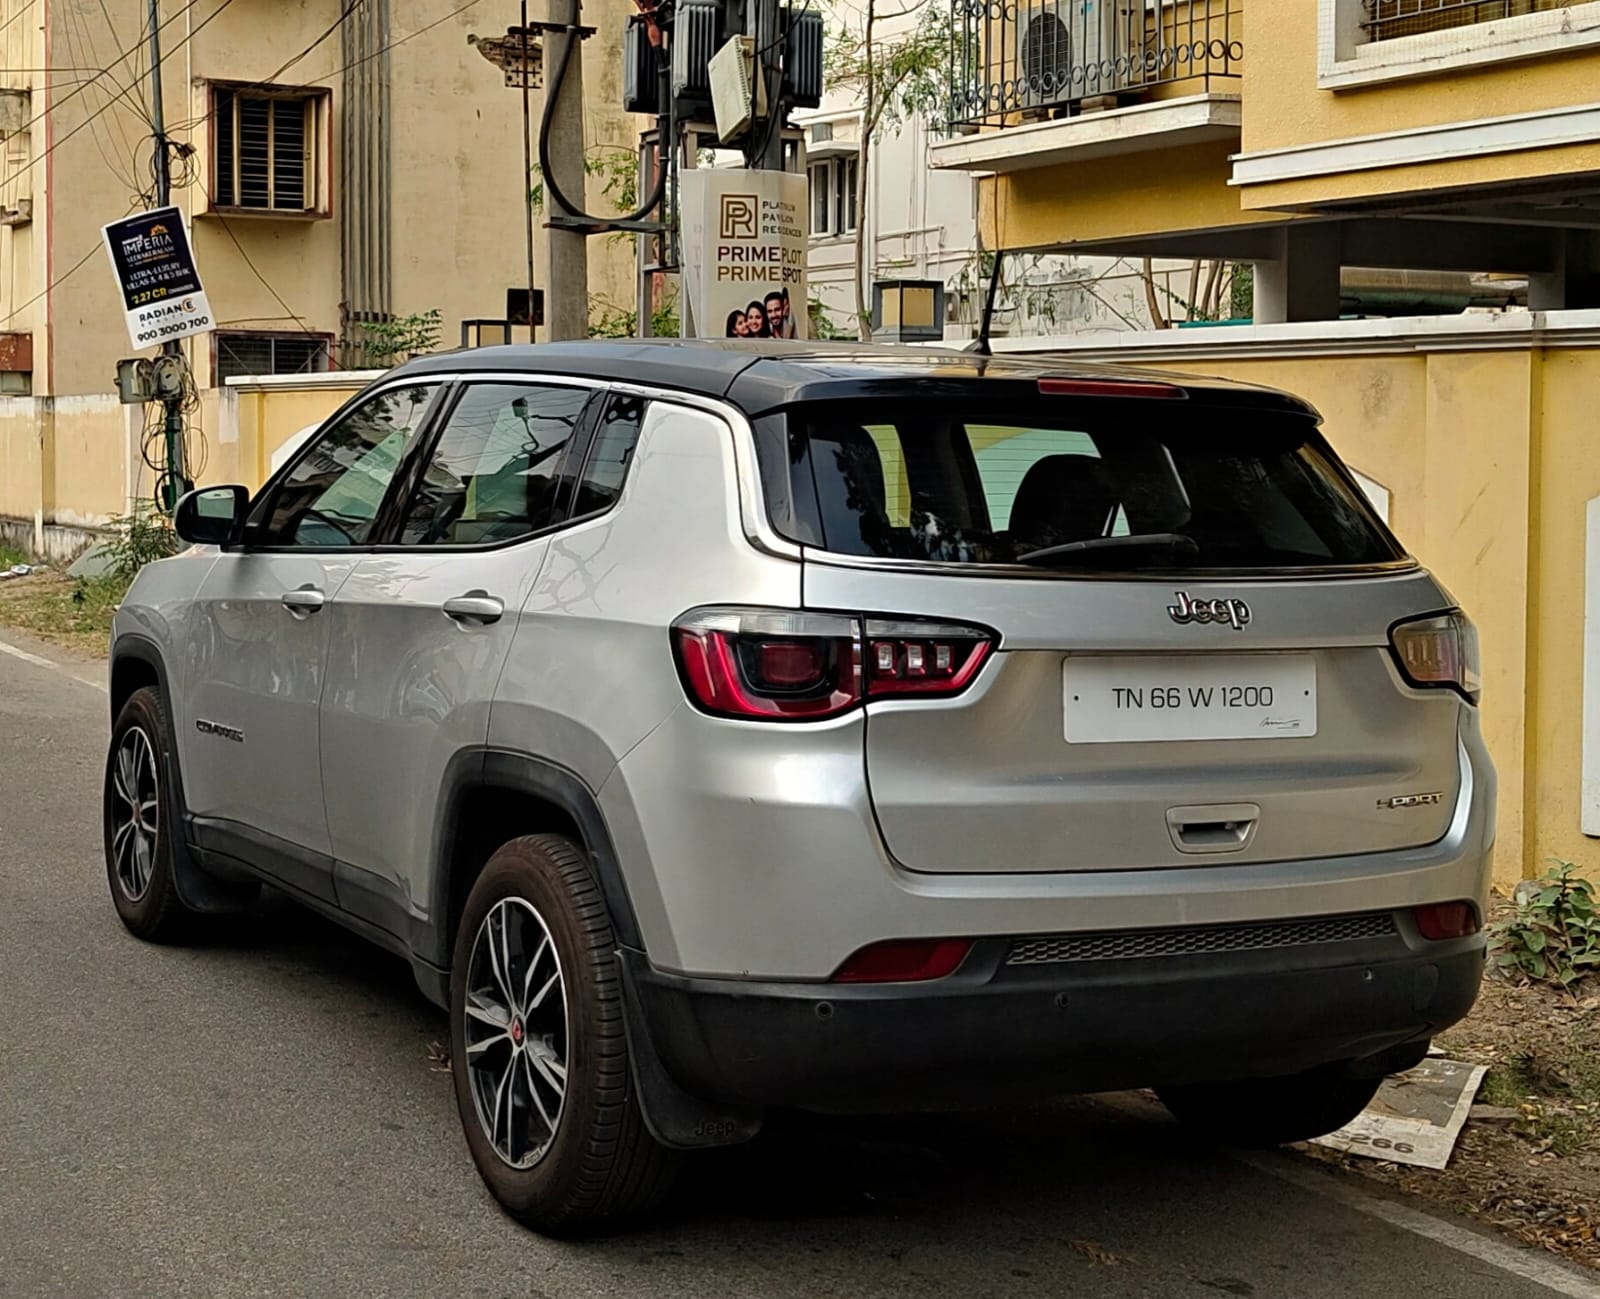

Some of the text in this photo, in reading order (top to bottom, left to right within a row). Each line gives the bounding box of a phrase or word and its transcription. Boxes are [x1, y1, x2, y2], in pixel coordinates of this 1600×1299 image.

[123, 234, 173, 256] IMPERIA
[717, 246, 802, 265] PRIME PLOT
[717, 266, 802, 284] PRIME SPOT
[152, 287, 167, 299] CR
[137, 316, 209, 342] 900 3000 700
[1167, 591, 1252, 631] Jeep
[1112, 686, 1273, 709] TN 66 W 1200
[694, 1119, 736, 1137] Jeep
